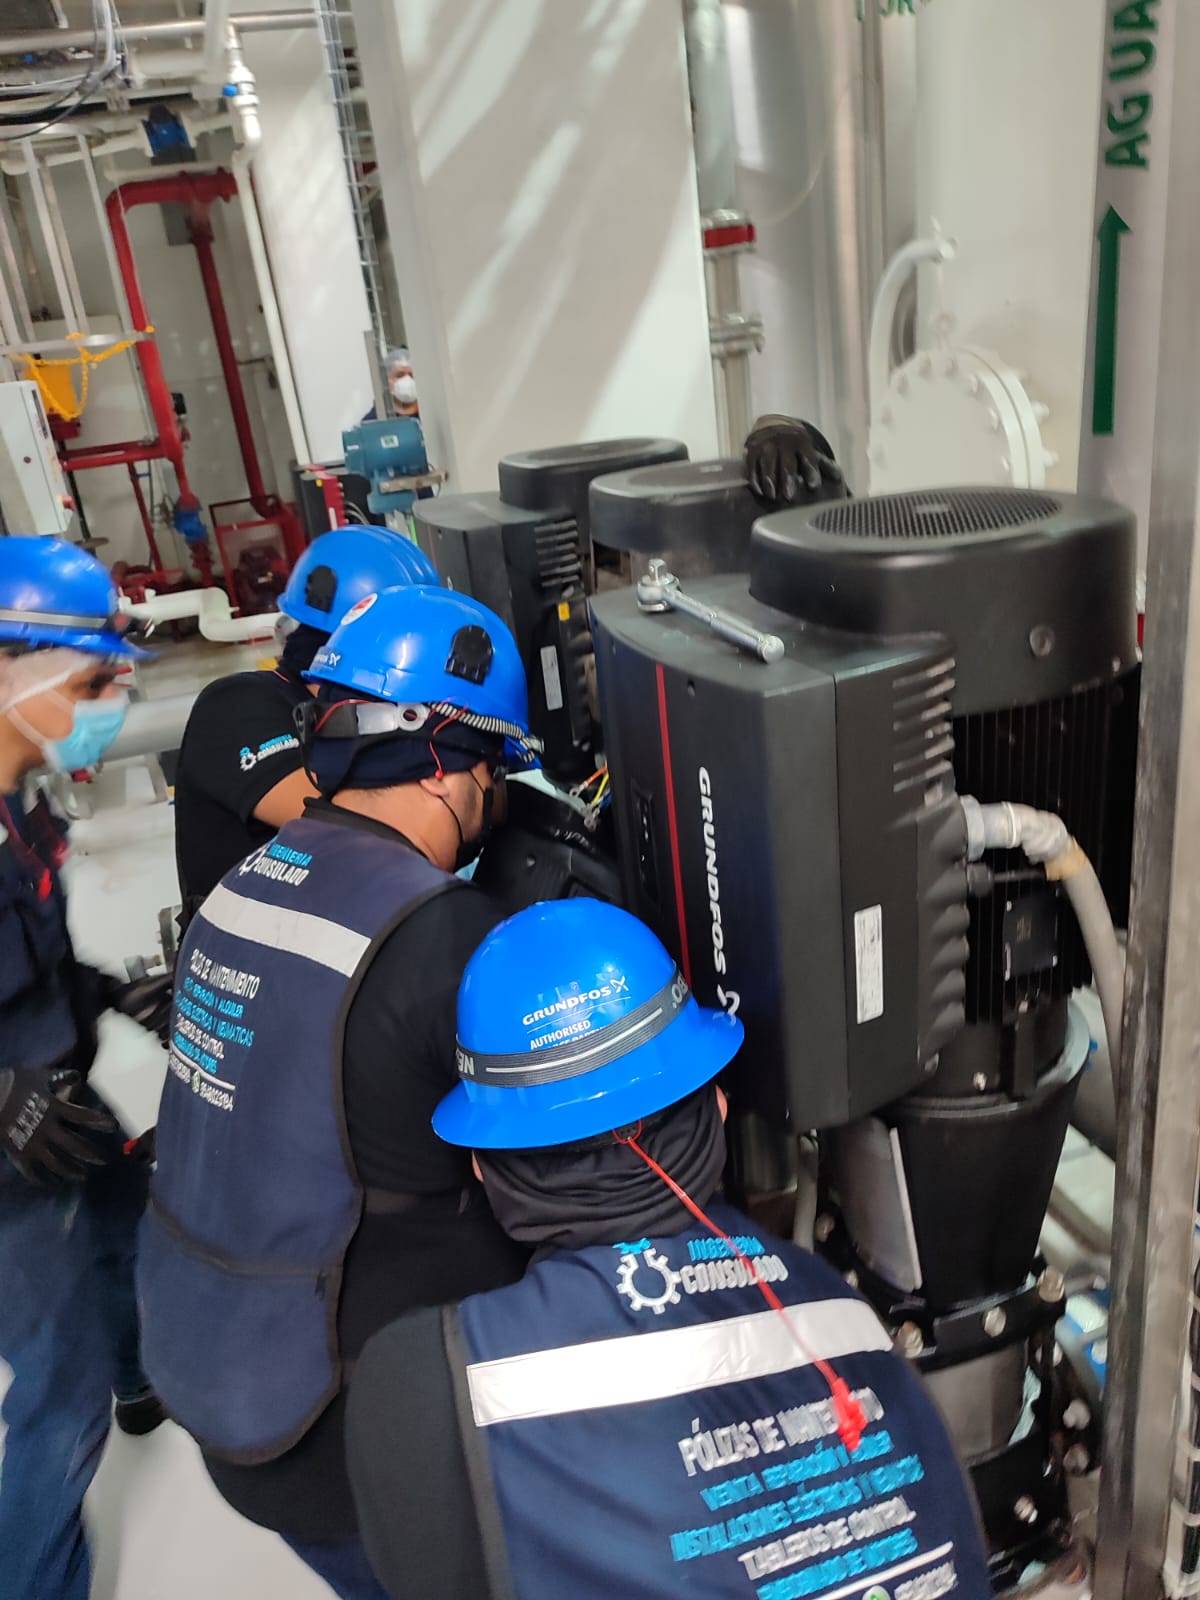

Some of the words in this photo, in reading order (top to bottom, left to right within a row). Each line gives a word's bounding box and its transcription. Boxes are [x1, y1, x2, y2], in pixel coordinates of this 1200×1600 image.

[1104, 0, 1159, 170] AGUA
[699, 766, 726, 975] GRUNDFOS
[522, 985, 612, 1026] GRUNDFOS
[530, 1019, 592, 1051] AUTHORISED
